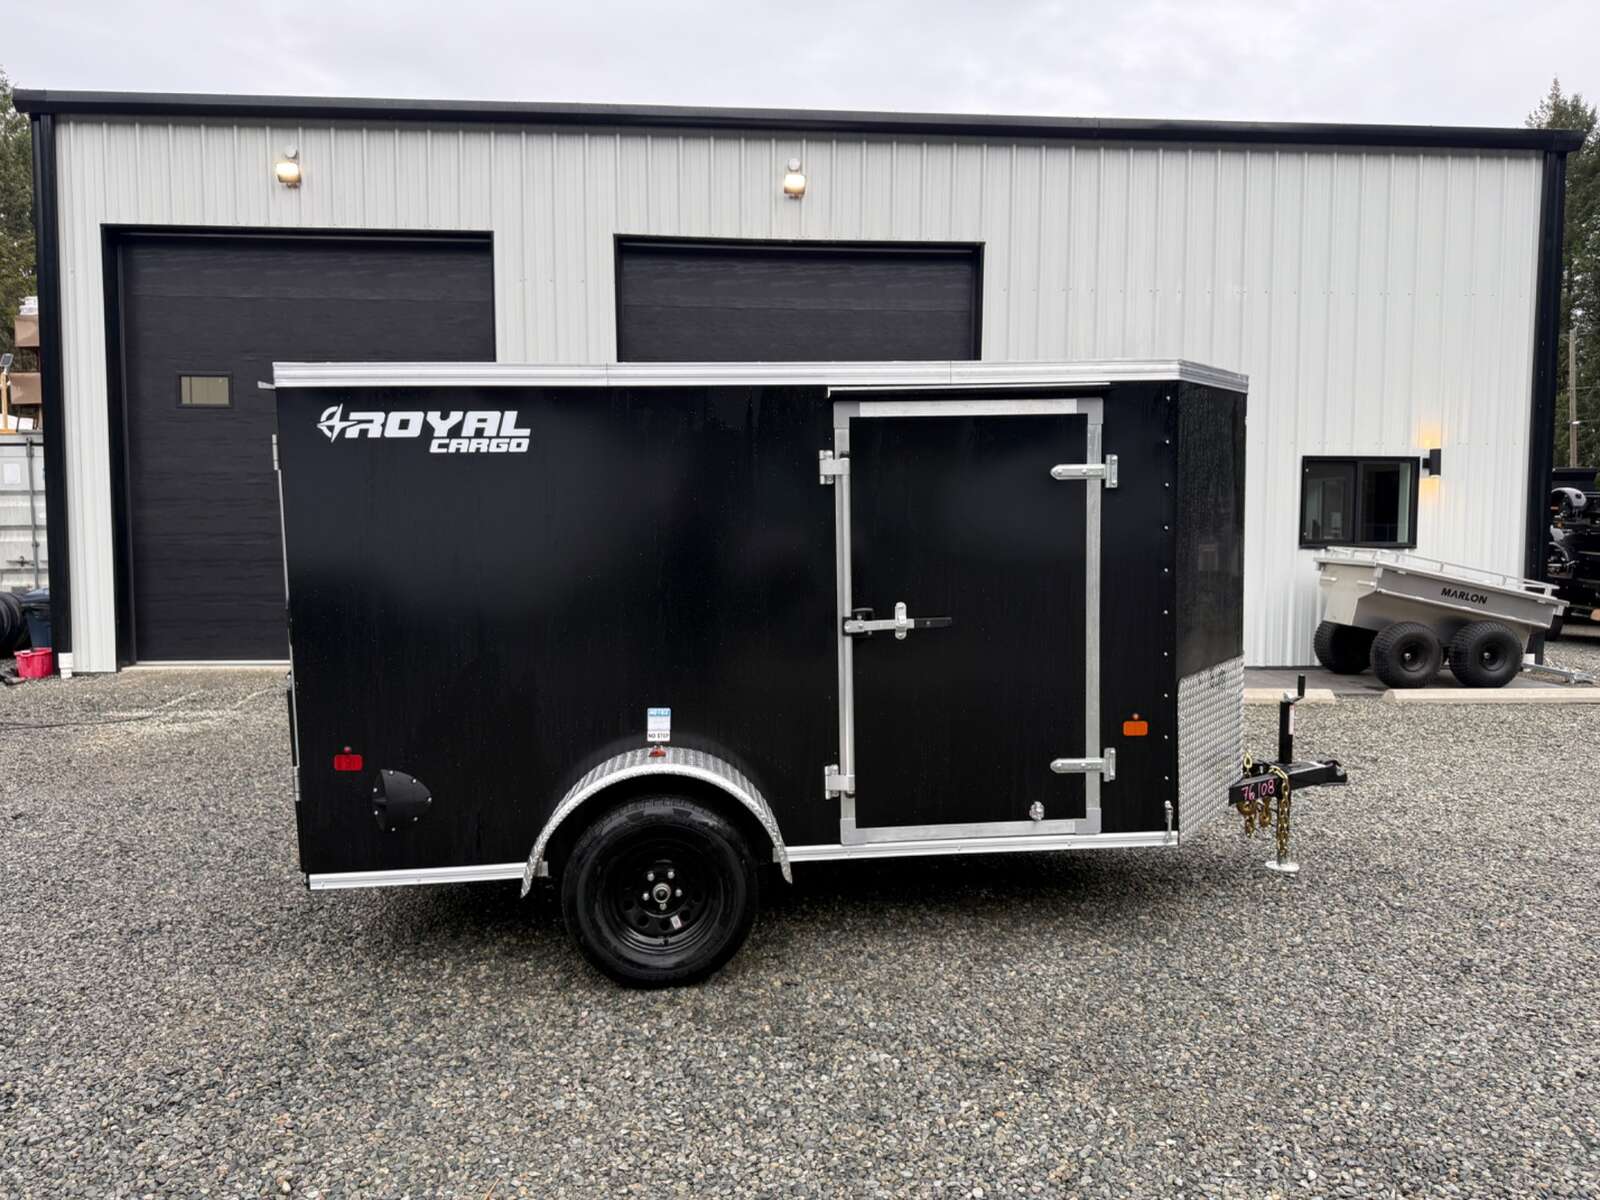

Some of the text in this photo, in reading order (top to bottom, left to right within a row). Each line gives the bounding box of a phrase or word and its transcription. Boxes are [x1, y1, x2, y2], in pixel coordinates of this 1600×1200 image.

[345, 410, 531, 438] ROYAL
[429, 438, 530, 453] CARGO
[1441, 587, 1488, 604] MARLON
